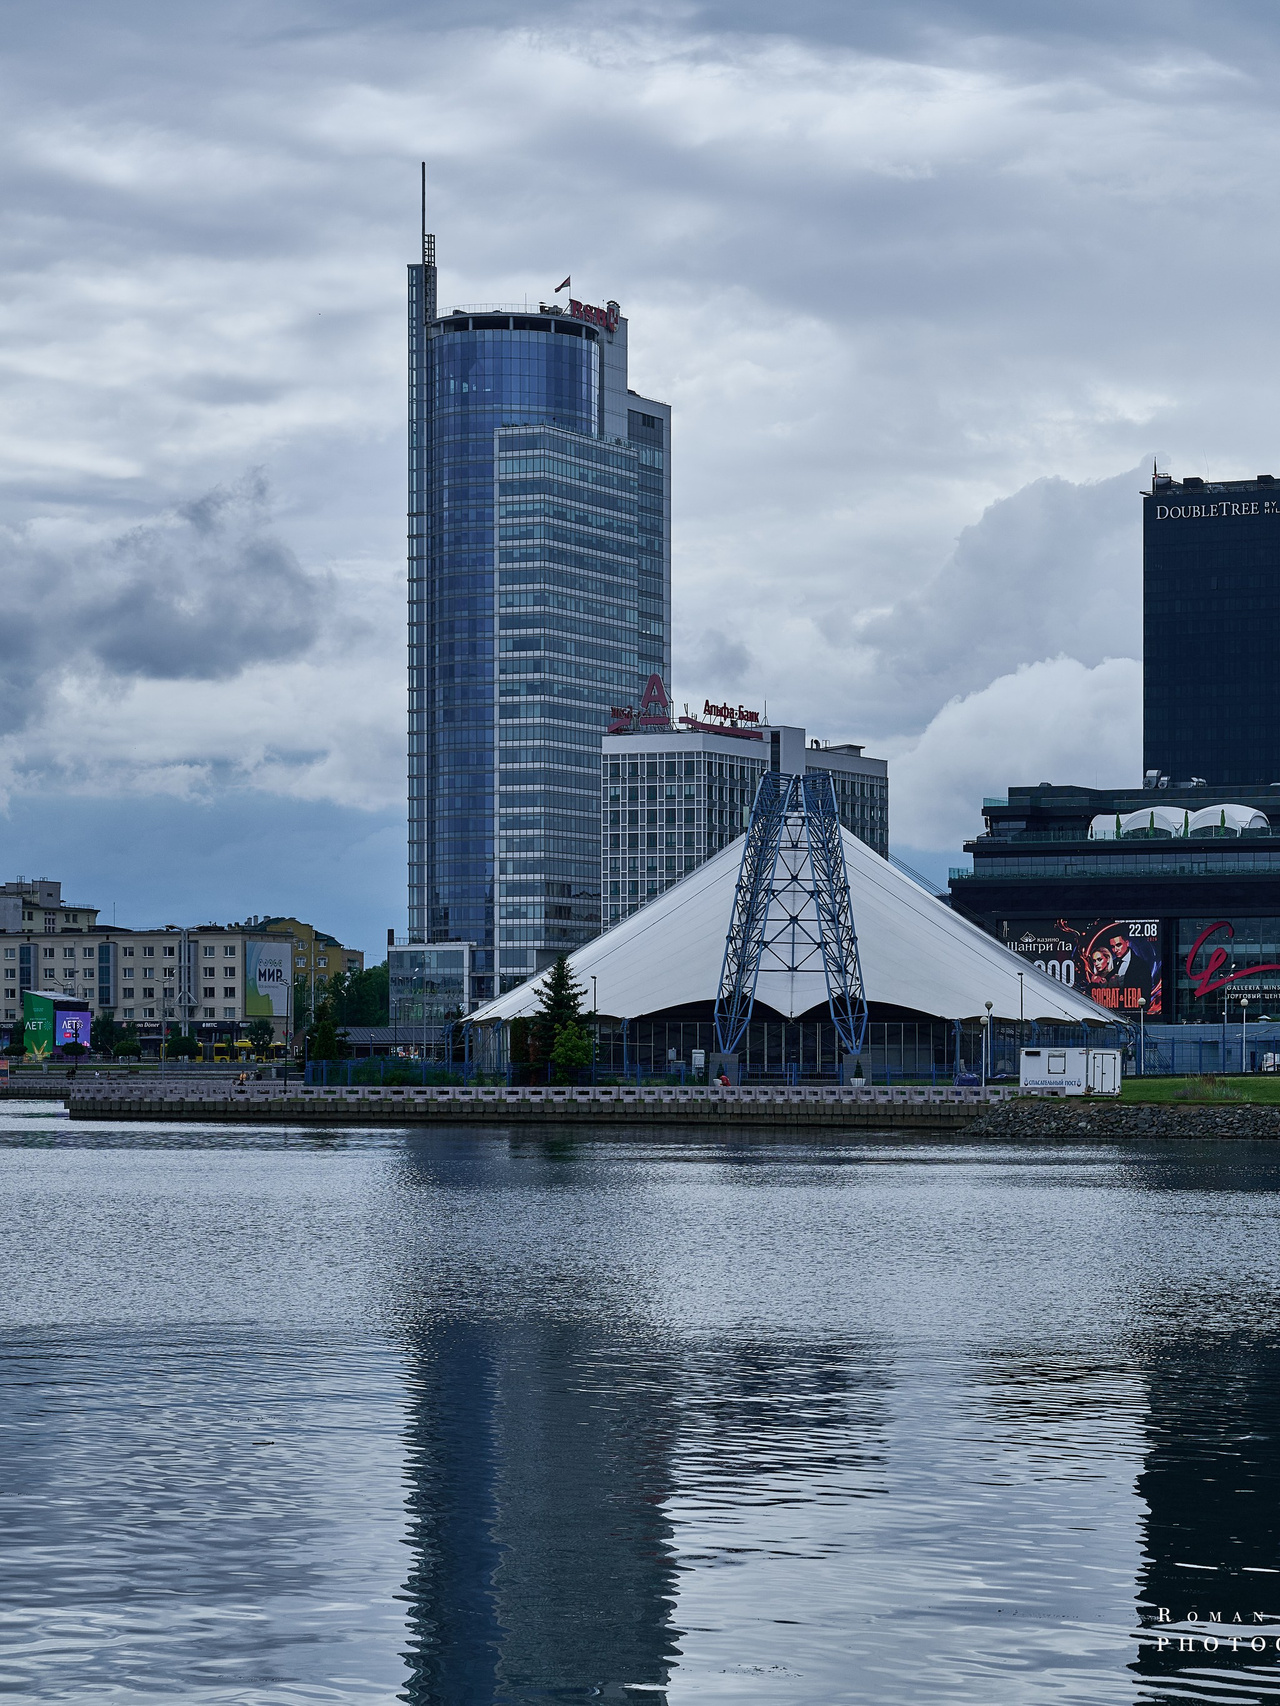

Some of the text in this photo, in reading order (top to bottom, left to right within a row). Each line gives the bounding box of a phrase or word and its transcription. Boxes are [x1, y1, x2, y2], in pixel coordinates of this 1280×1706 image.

[1129, 923, 1158, 937] 22.08
[1006, 941, 1053, 954] Шангри
[258, 968, 283, 982] МИР
